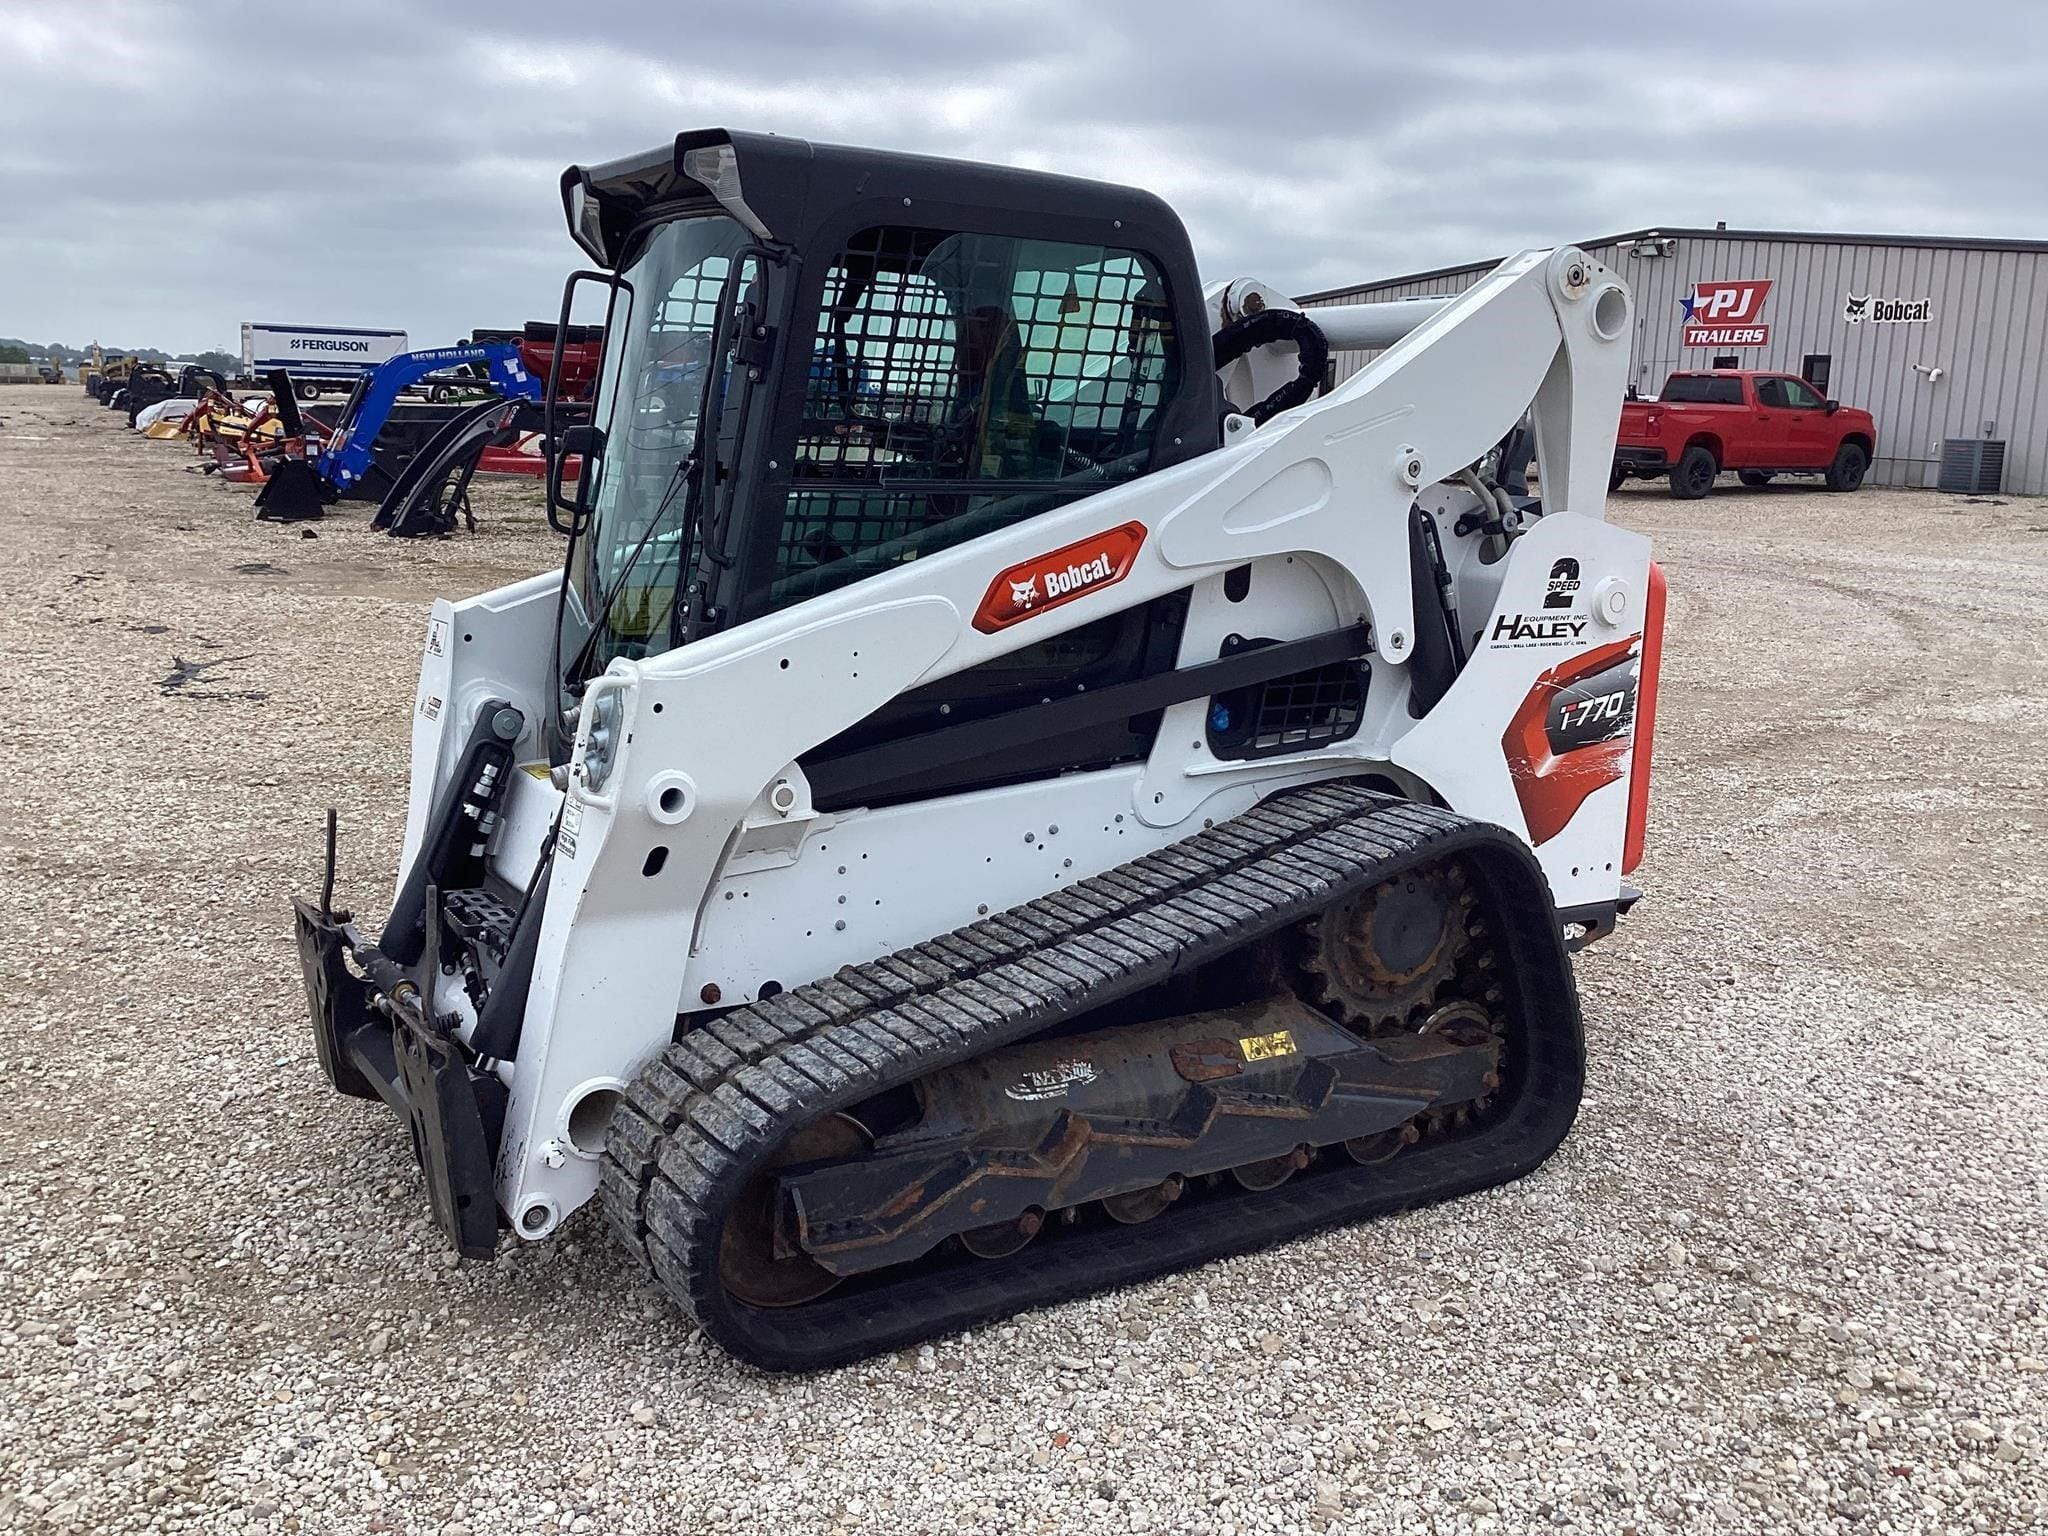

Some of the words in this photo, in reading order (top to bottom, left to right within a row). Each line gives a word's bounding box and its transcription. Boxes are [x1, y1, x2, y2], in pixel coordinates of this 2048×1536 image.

[1707, 288, 1754, 318] PJ
[1873, 299, 1930, 321] Bobcat
[1688, 329, 1766, 343] TRAILERS
[302, 339, 369, 352] FERGUSON
[411, 351, 436, 361] NEW
[438, 348, 486, 360] HOLLAND
[1044, 553, 1112, 598] Bobcat
[1543, 557, 1580, 609] 2
[1547, 580, 1581, 592] SPEED
[1491, 614, 1588, 640] HALEY
[1523, 615, 1571, 623] EQUIPMENT
